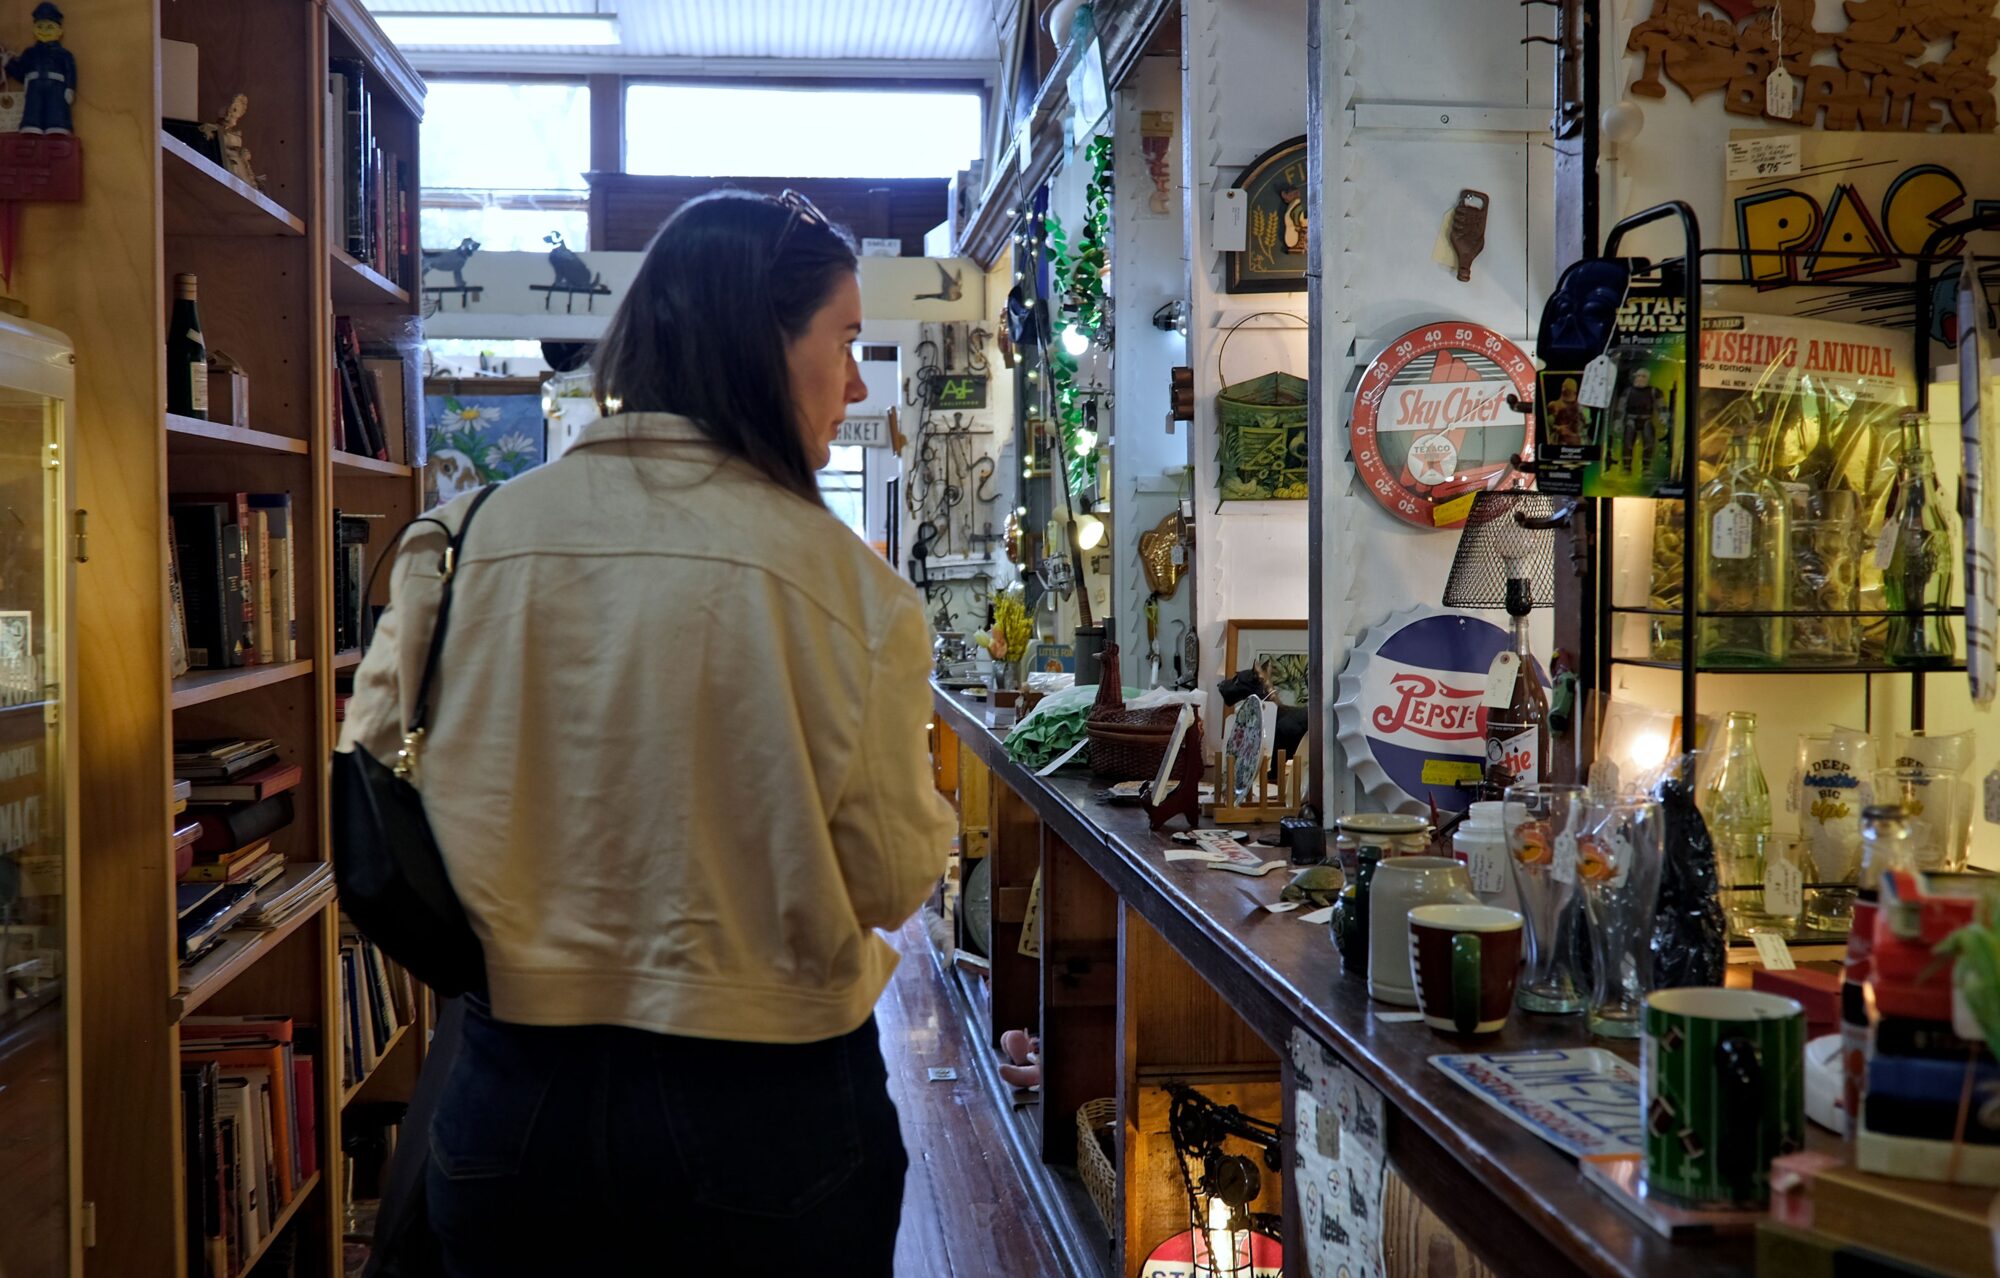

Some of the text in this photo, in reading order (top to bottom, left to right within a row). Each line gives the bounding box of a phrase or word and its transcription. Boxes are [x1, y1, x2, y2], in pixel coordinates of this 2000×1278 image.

[1616, 296, 1687, 315] STAR
[1425, 330, 1442, 342] 40
[1455, 329, 1473, 341] 50
[1396, 341, 1412, 357] 30
[1485, 338, 1502, 353] 60
[1700, 331, 1896, 377] FISHING ANNUAL
[1373, 362, 1389, 380] 20
[1510, 355, 1525, 373] 70
[1720, 364, 1752, 373] EDITION
[1360, 390, 1372, 406] 10
[1396, 383, 1506, 428] Sky Chief
[837, 422, 880, 441] RKET
[1357, 426, 1367, 435] 0
[1414, 445, 1450, 454] TEXACO
[1812, 759, 1850, 772] DEEP
